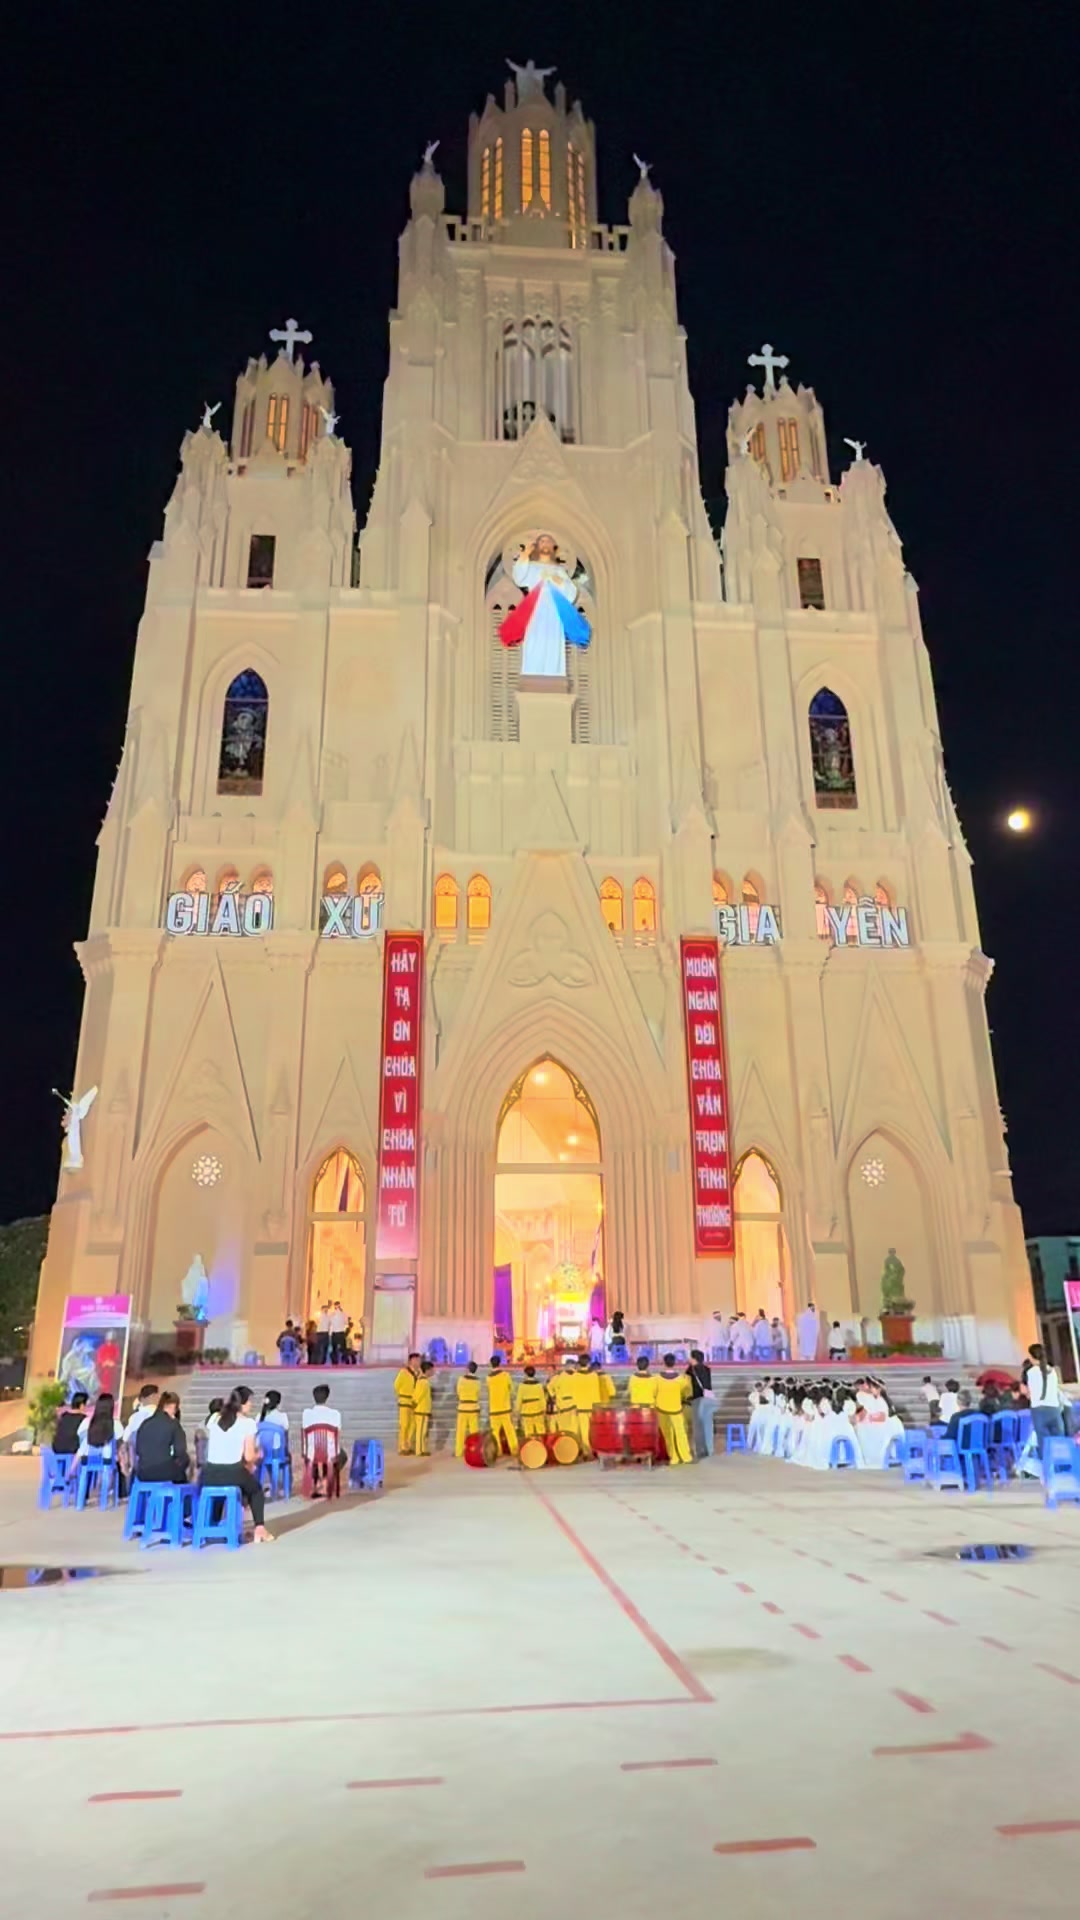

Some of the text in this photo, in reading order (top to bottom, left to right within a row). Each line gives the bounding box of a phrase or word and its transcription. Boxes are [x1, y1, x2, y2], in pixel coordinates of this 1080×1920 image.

[166, 880, 910, 948] GIÁO XỨ GIA YÊN
[390, 949, 417, 973] HÃY
[685, 953, 717, 978] MUÔN
[394, 985, 411, 1011] TẠ
[687, 986, 719, 1011] NGÀN
[384, 1051, 417, 1077] CHÚA
[691, 1055, 722, 1081] CHÚA
[393, 1087, 407, 1114] VÌ
[383, 1123, 415, 1150] CHÚA
[695, 1129, 727, 1157] TRỌN
[381, 1161, 416, 1189] NHÂN
[697, 1162, 728, 1190] TÌNH
